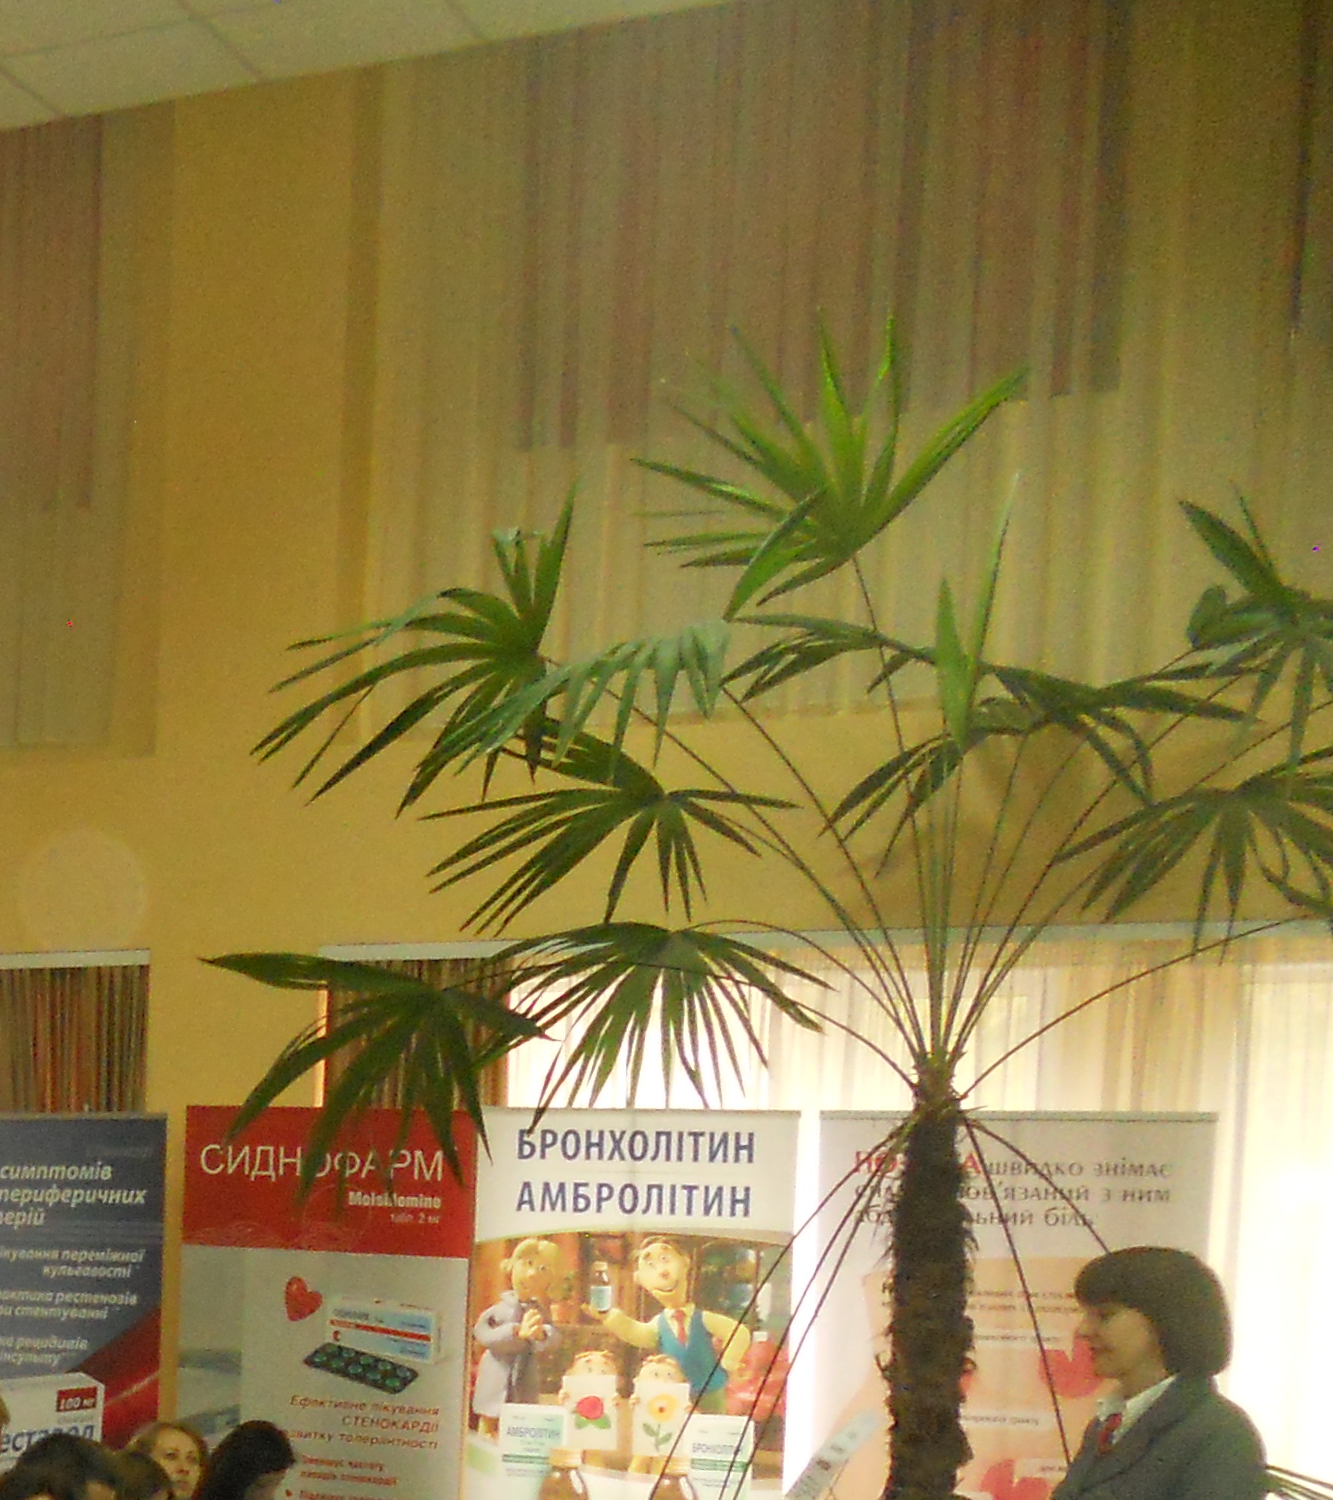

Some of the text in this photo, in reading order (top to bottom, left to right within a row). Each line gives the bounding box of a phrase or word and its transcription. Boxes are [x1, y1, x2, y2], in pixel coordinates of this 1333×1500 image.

[516, 1128, 756, 1164] БРОНХОЛІТИН
[0, 1160, 112, 1181] симптомів
[515, 1181, 752, 1218] АМБРОЛІТИН
